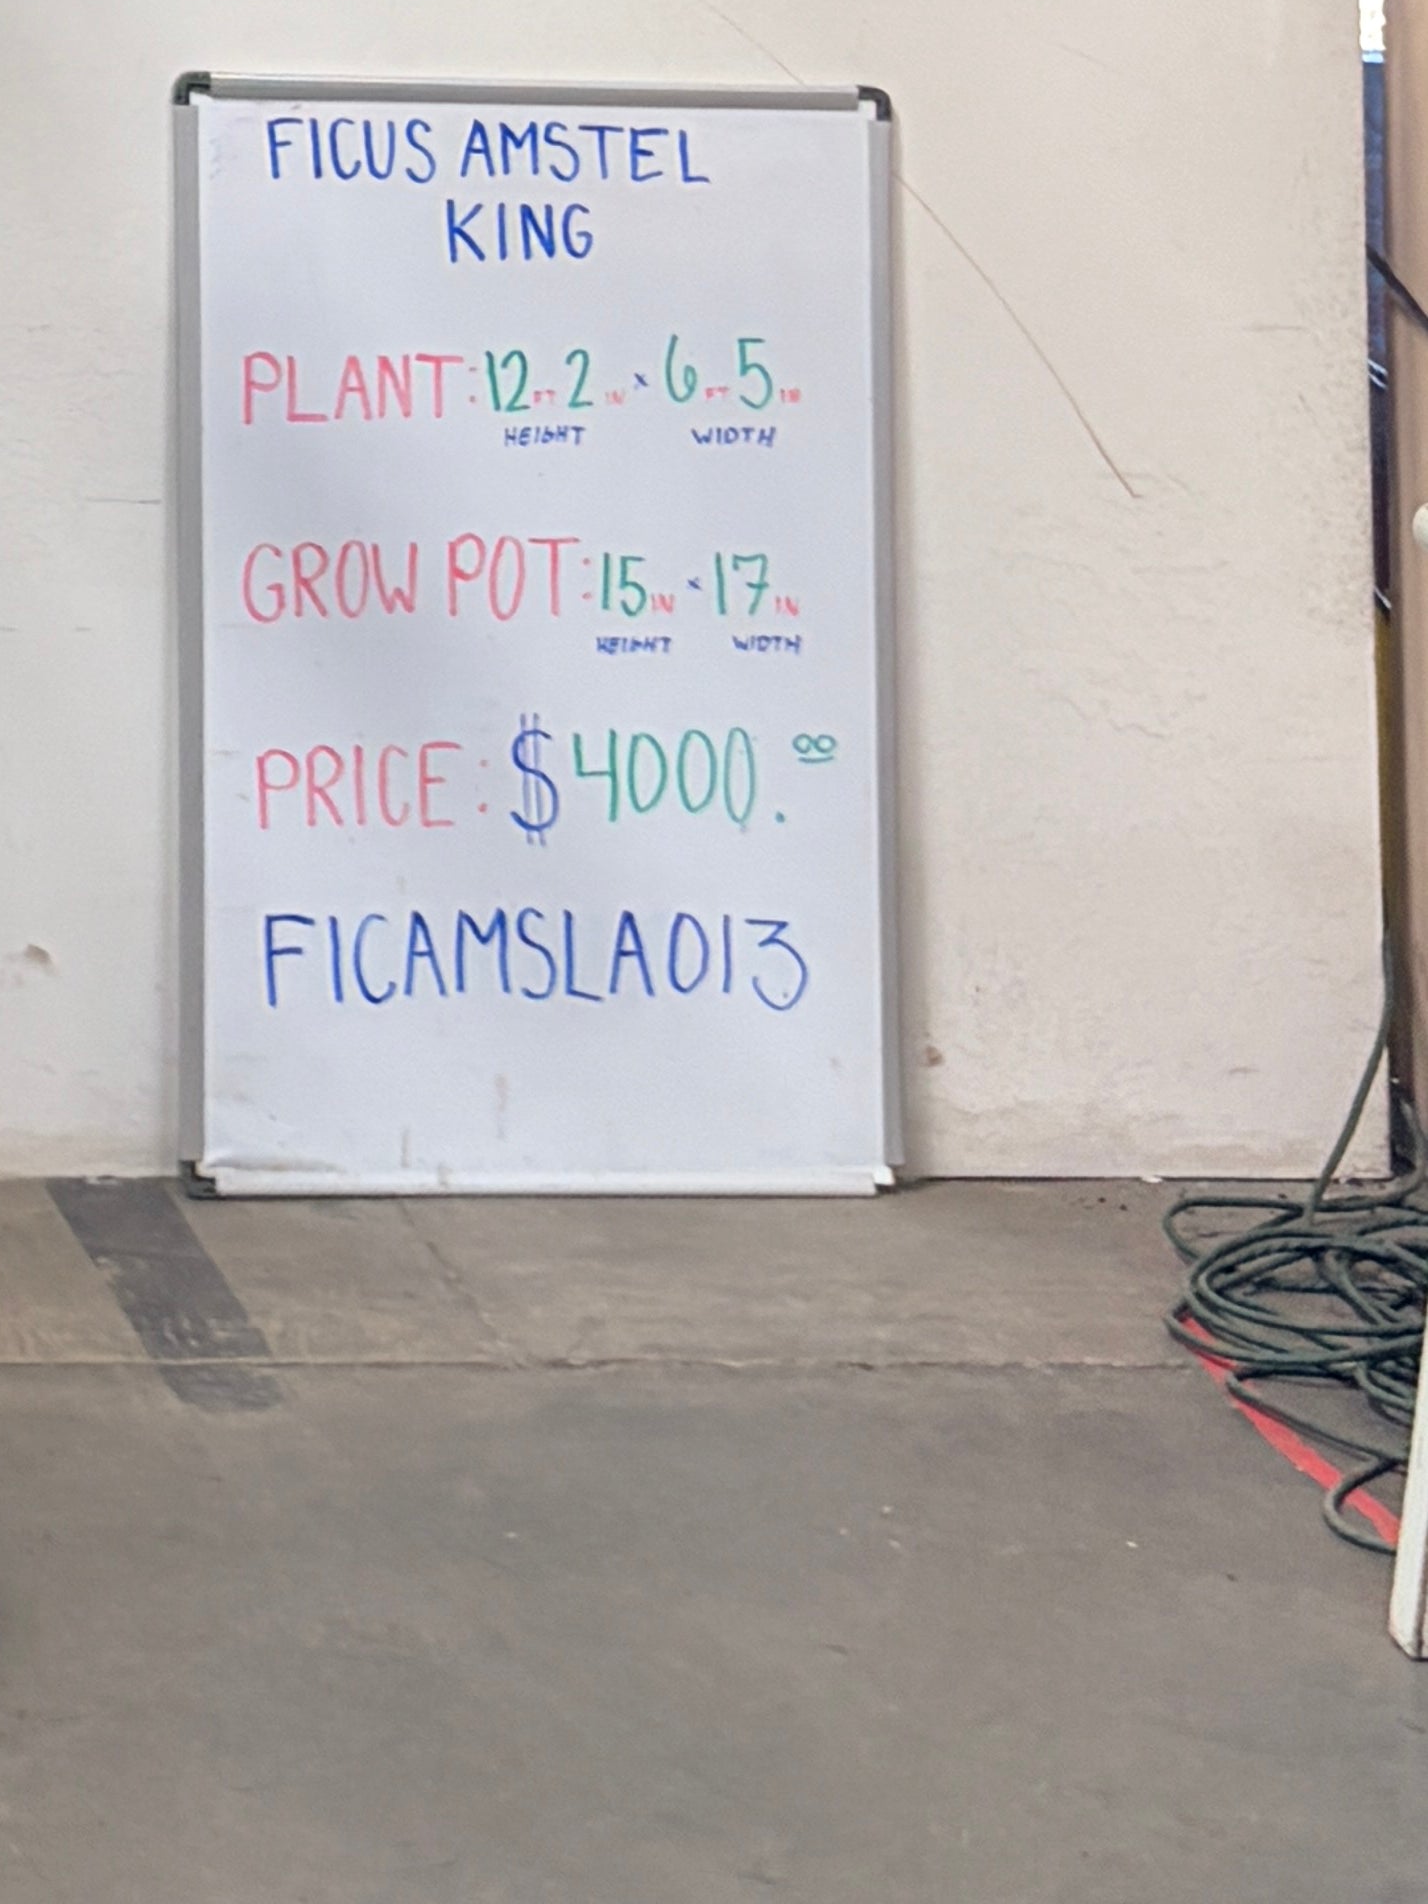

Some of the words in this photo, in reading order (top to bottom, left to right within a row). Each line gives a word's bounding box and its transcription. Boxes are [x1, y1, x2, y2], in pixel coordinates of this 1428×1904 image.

[267, 117, 436, 184] FICUS
[460, 119, 710, 184] AMSTEL
[445, 200, 593, 263] KING
[243, 350, 479, 425] PLANT:
[504, 425, 586, 447] HEIGHT
[691, 426, 777, 448] WIDTH
[243, 539, 418, 624] GROW
[447, 533, 594, 621] POT:
[596, 635, 672, 655] HEIGHT
[731, 634, 802, 655] WIDTH
[255, 741, 489, 830] PRICE:
[262, 907, 809, 1012] FICAMSLA013
